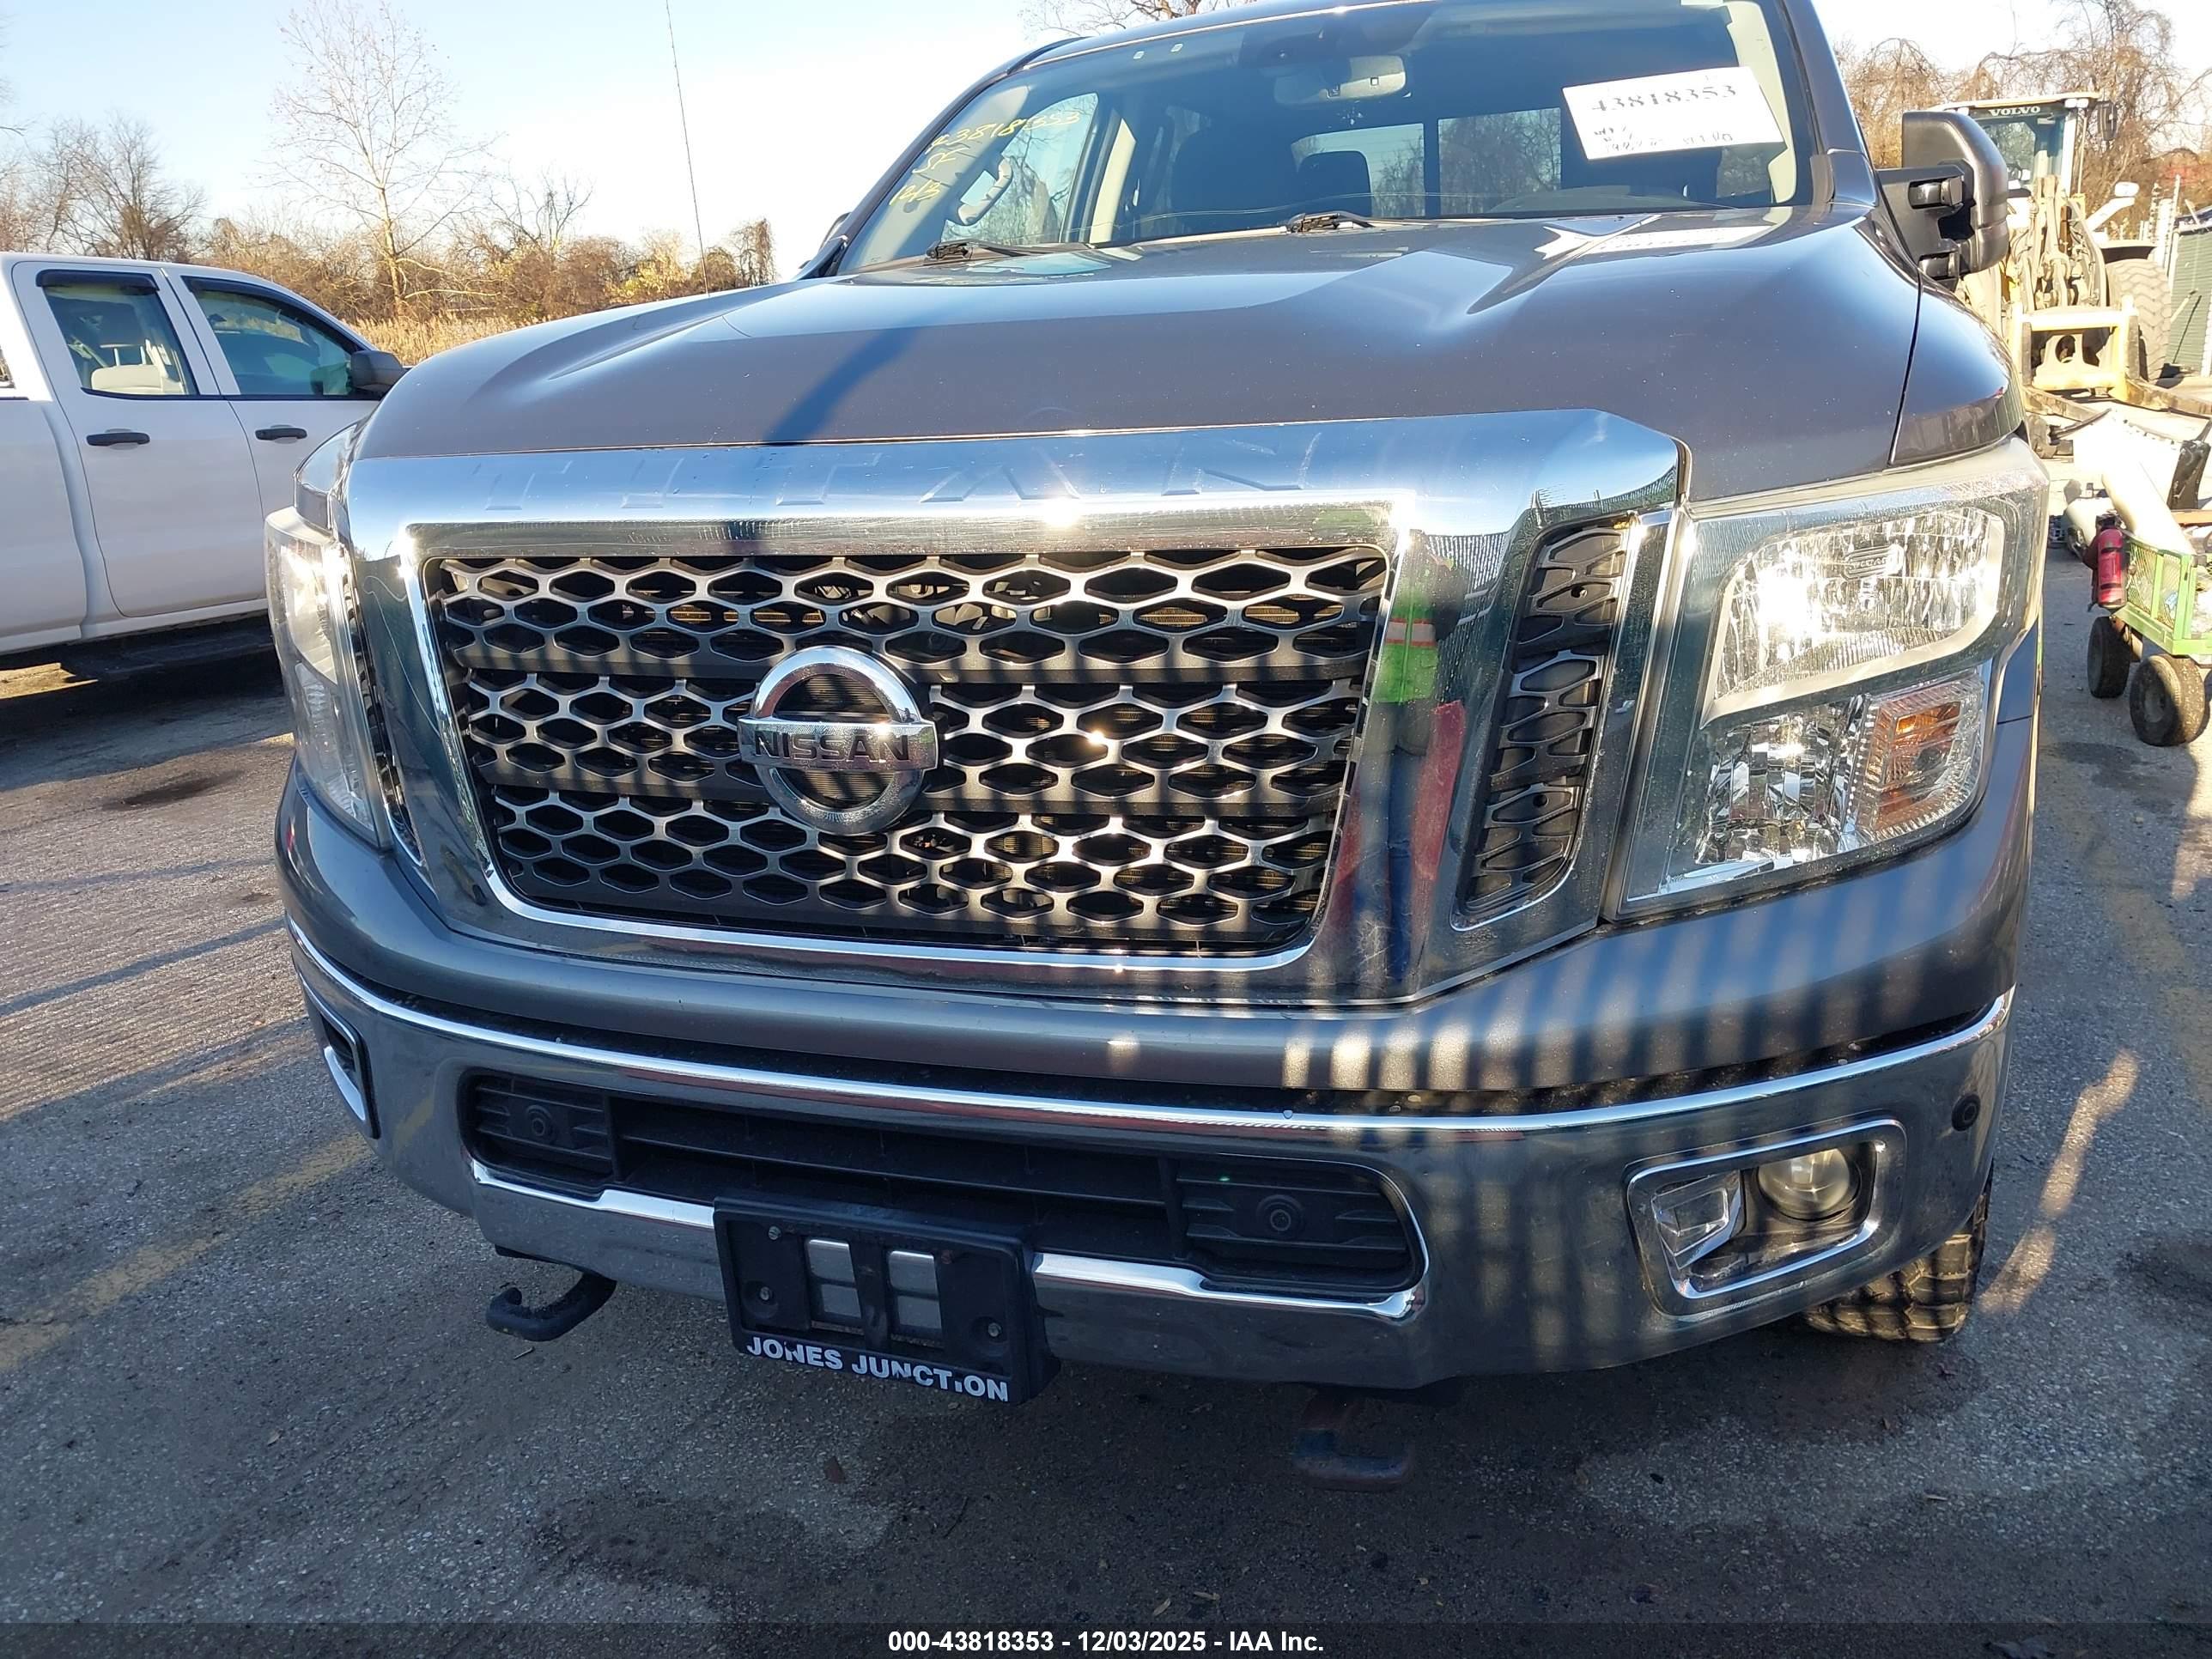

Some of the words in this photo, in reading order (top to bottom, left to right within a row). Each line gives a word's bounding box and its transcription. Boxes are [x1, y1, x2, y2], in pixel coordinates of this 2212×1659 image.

[1591, 85, 1736, 112] 43818353
[1987, 105, 2041, 117] VOLVO
[754, 731, 910, 763] NISSAN
[746, 1335, 843, 1370] JONES
